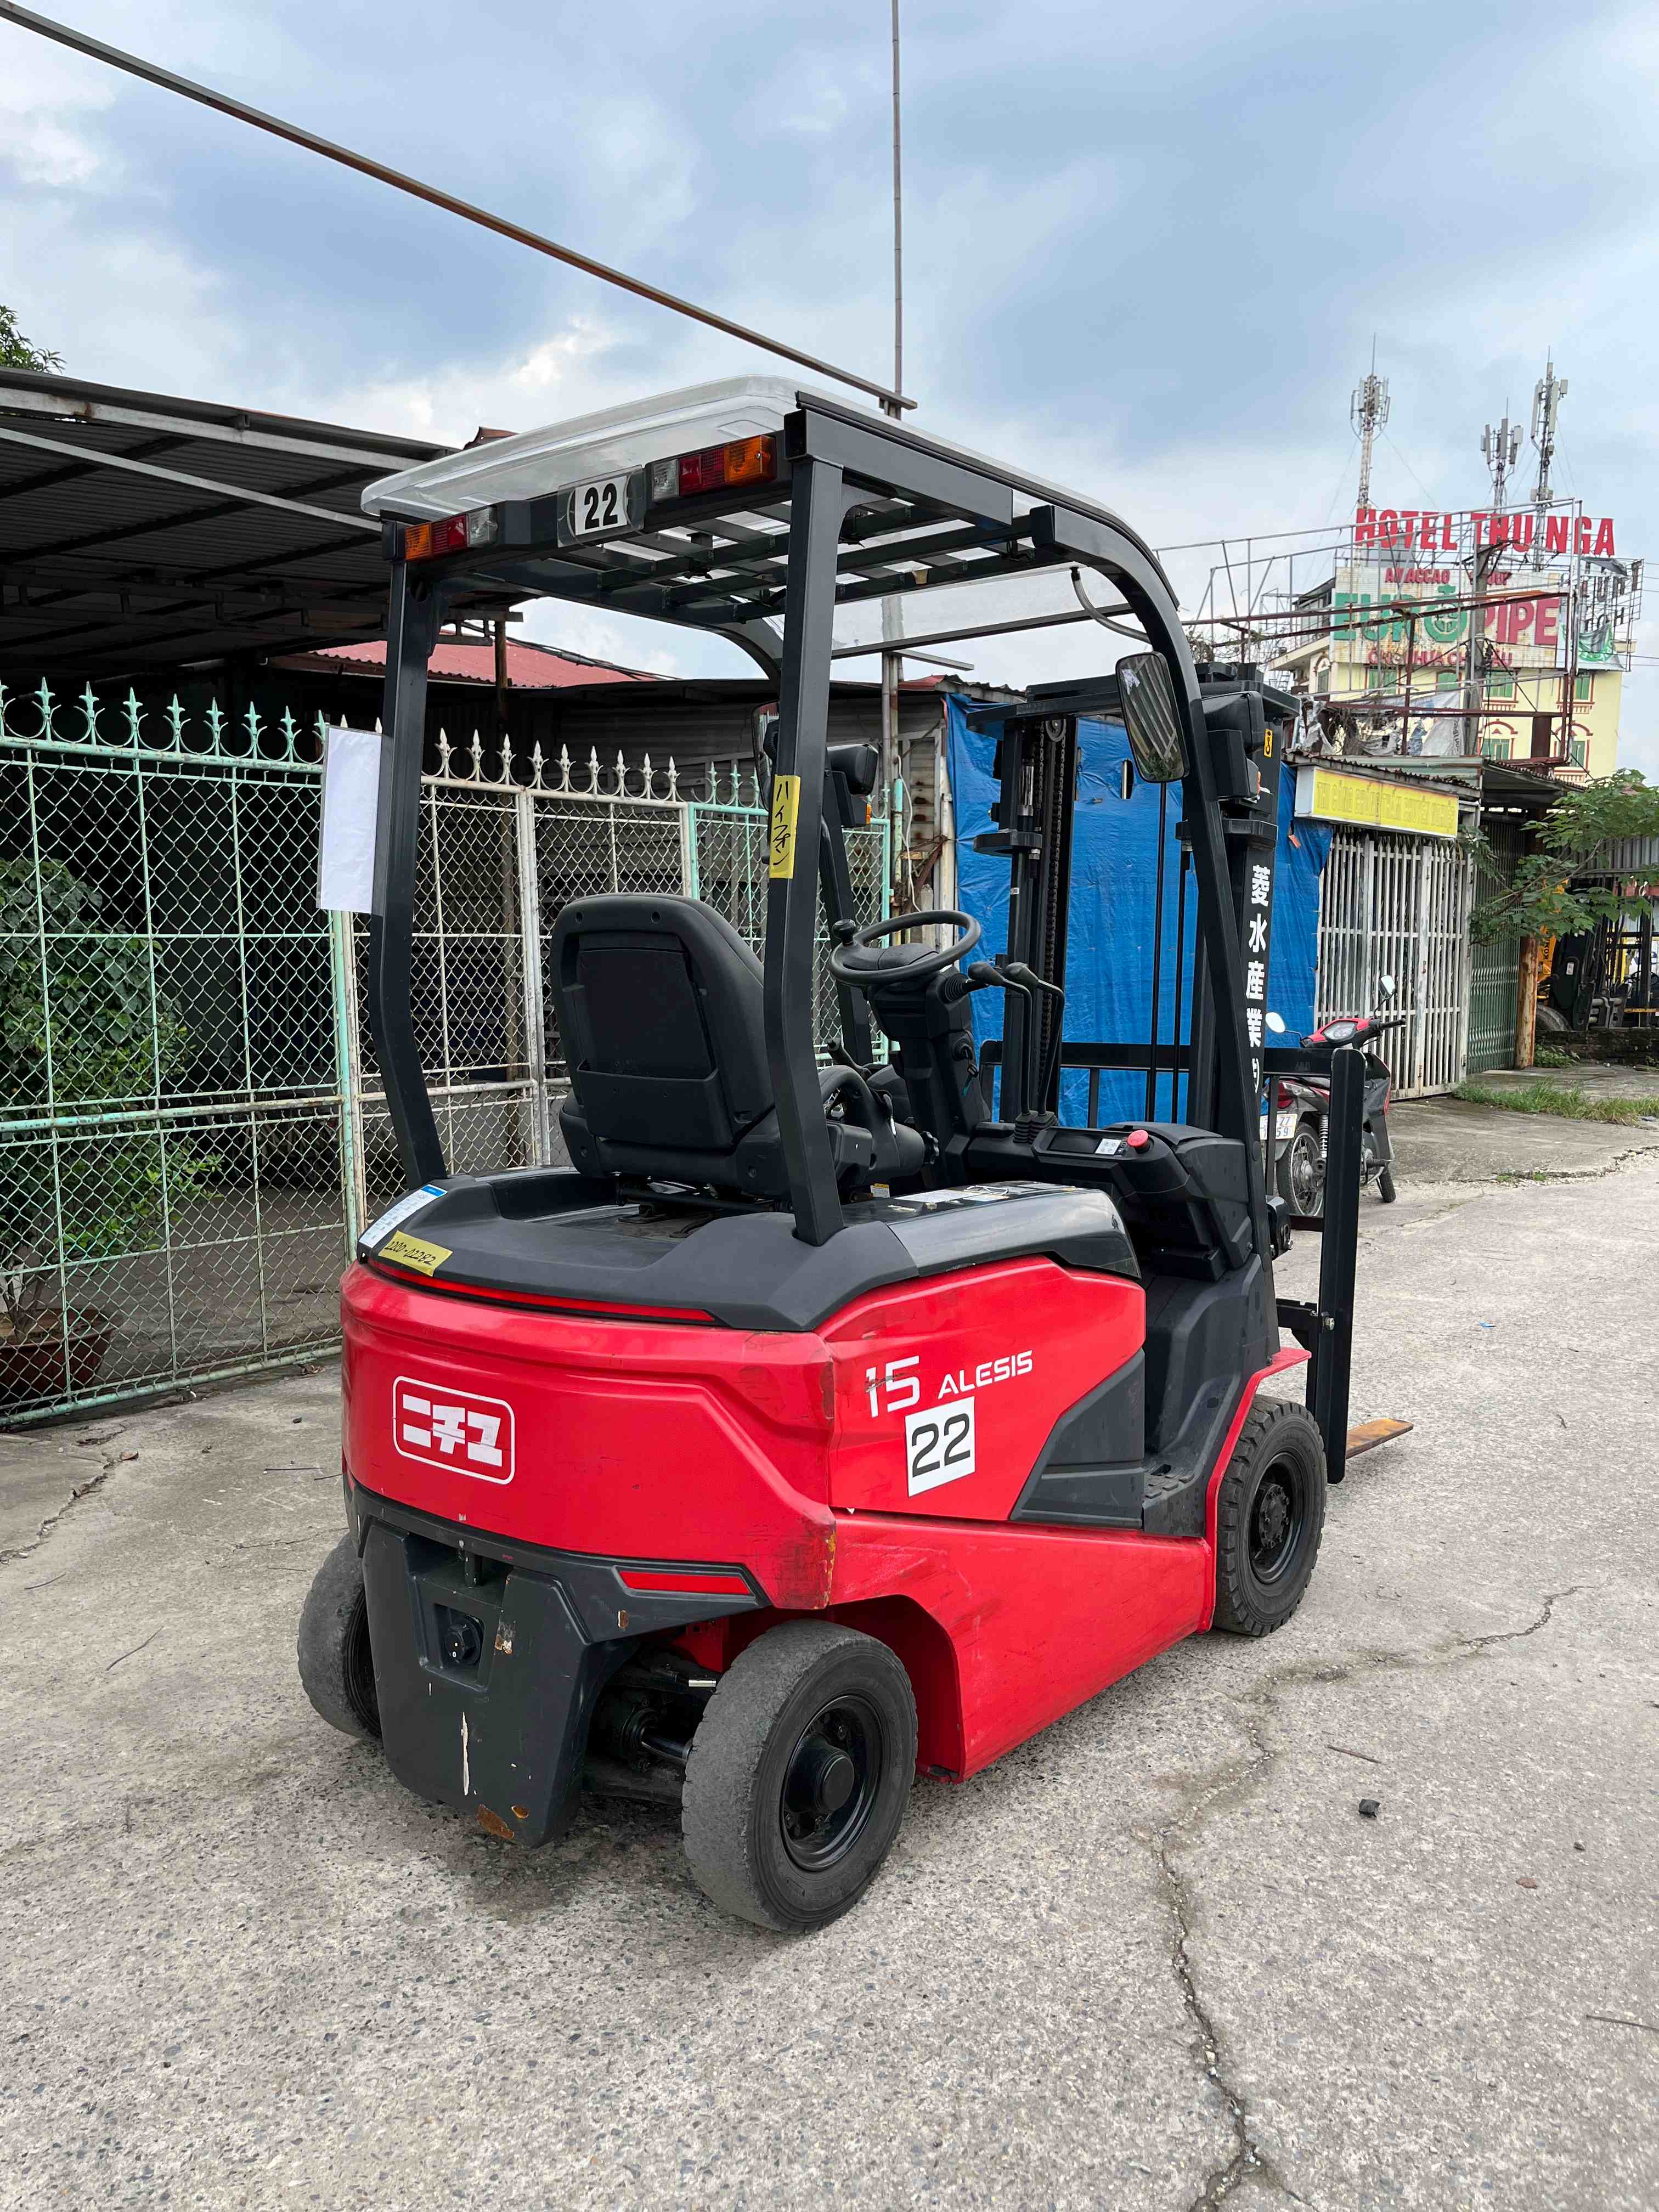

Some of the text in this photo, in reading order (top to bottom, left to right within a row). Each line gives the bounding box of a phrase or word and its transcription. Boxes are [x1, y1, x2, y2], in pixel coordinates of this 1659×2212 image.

[584, 483, 618, 530] 22
[1355, 509, 1457, 550] HOTEL
[865, 1350, 1033, 1418] 15 ALESIS
[911, 1413, 970, 1477] 22
